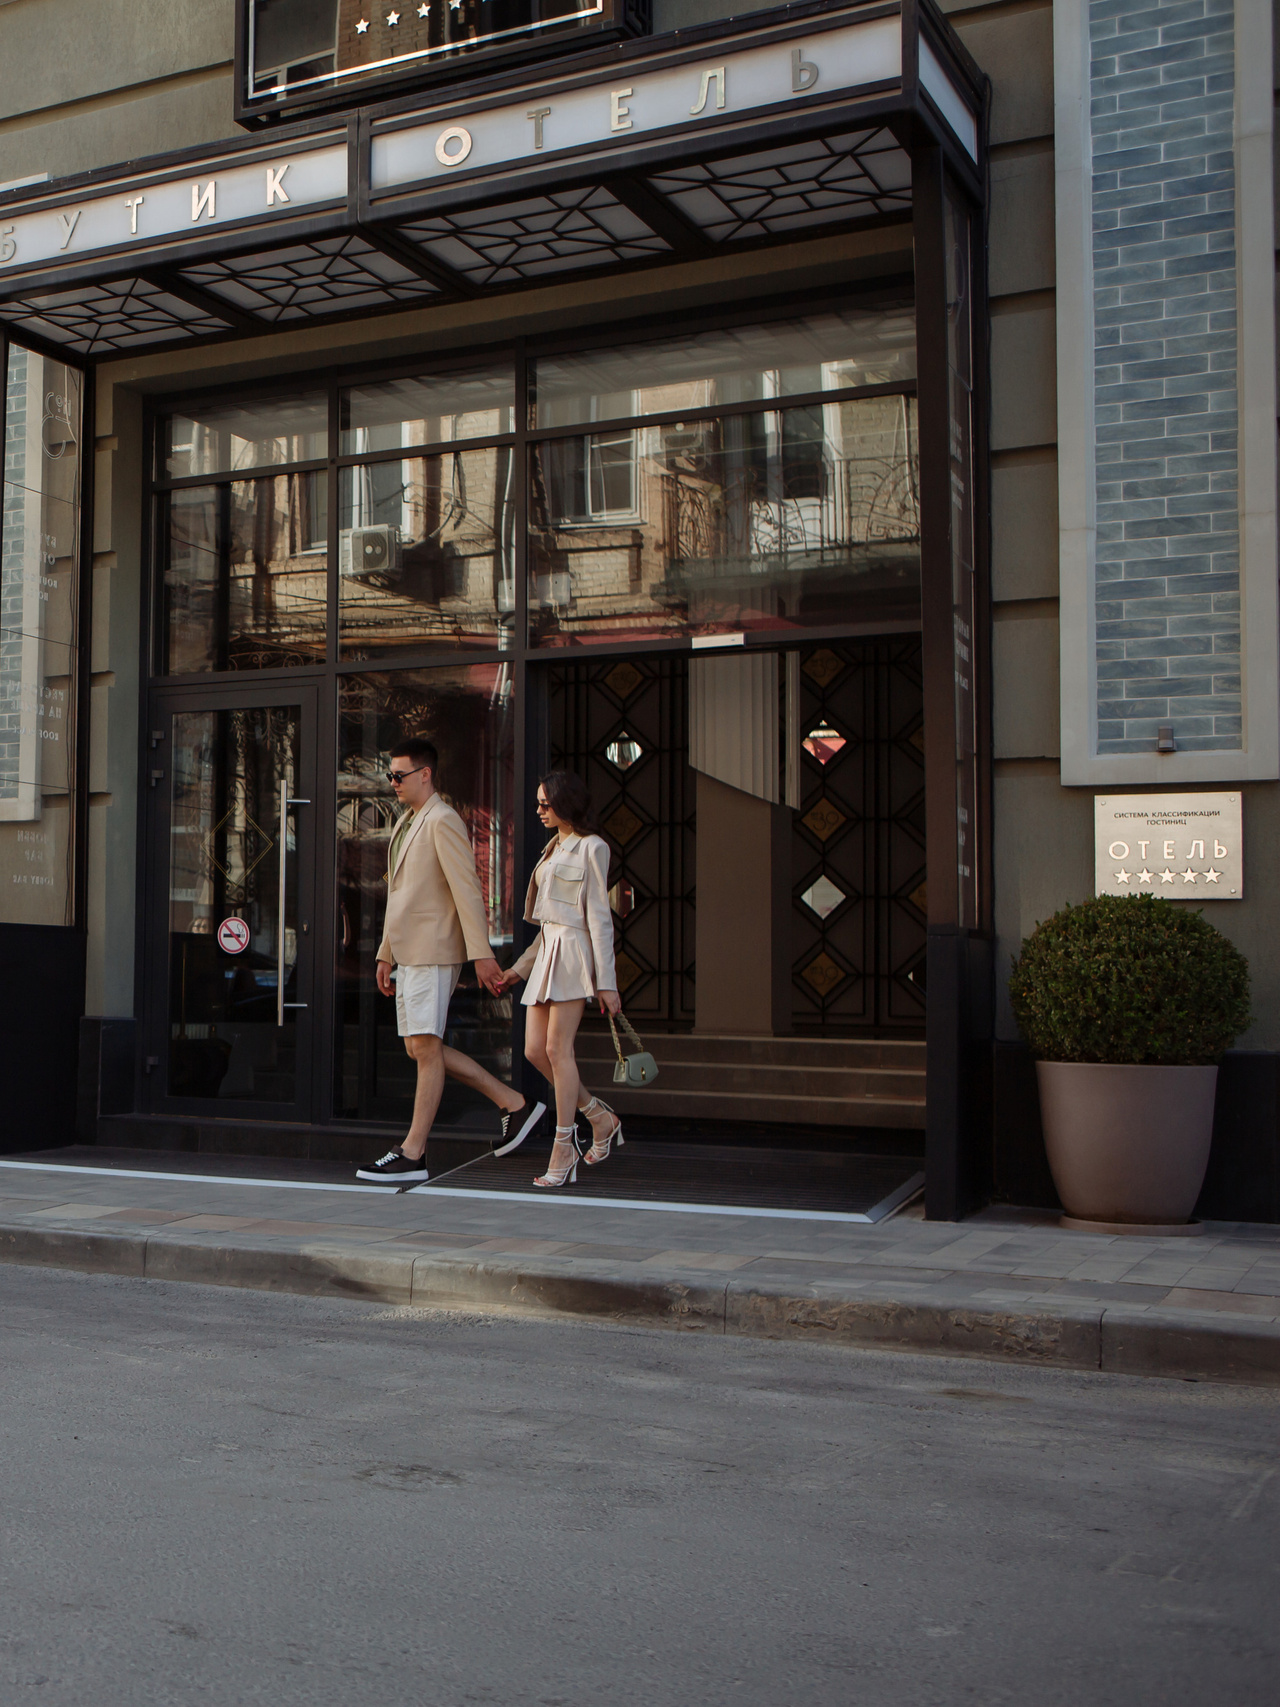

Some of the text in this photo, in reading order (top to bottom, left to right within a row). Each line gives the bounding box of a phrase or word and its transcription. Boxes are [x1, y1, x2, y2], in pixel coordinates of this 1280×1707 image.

[434, 48, 819, 167] ОТЕЛЬ
[1151, 810, 1221, 818] КЛАССИФИКАЦИИ
[1108, 839, 1228, 860] ОТЕЛЬ
